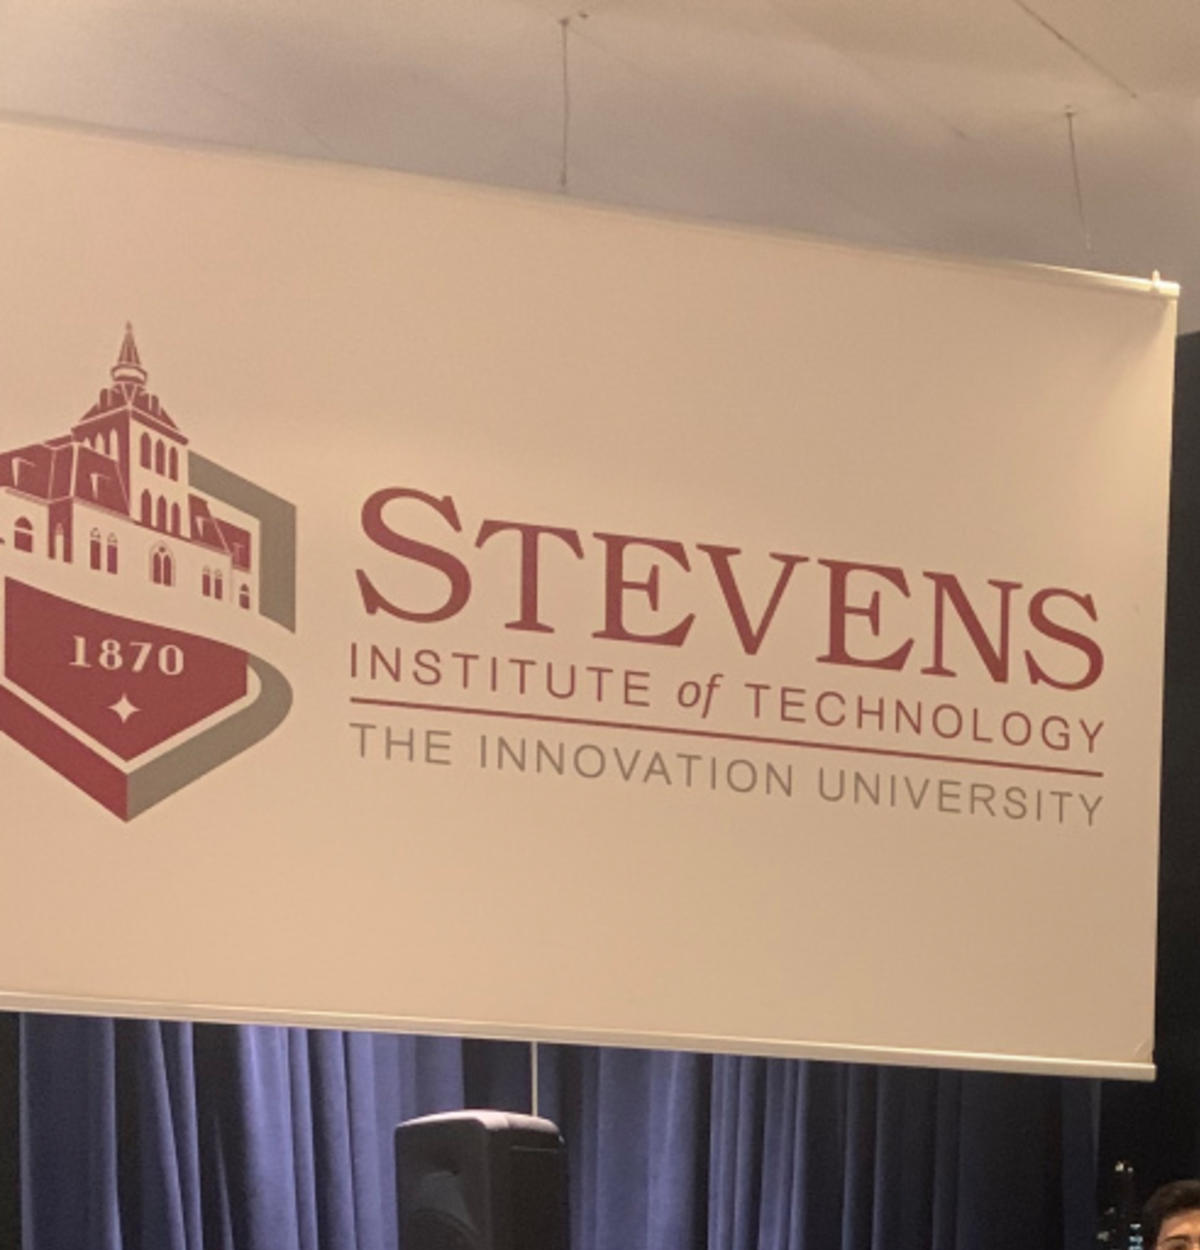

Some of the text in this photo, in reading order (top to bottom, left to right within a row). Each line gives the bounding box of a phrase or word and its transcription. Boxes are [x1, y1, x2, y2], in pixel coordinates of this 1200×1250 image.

[354, 486, 1105, 692] STEVENS
[69, 635, 185, 676] 1870
[350, 642, 1104, 754] INSTITUTE of TECHNOLOGY
[349, 722, 1103, 826] THE INNOVATION UNIVERSITY
